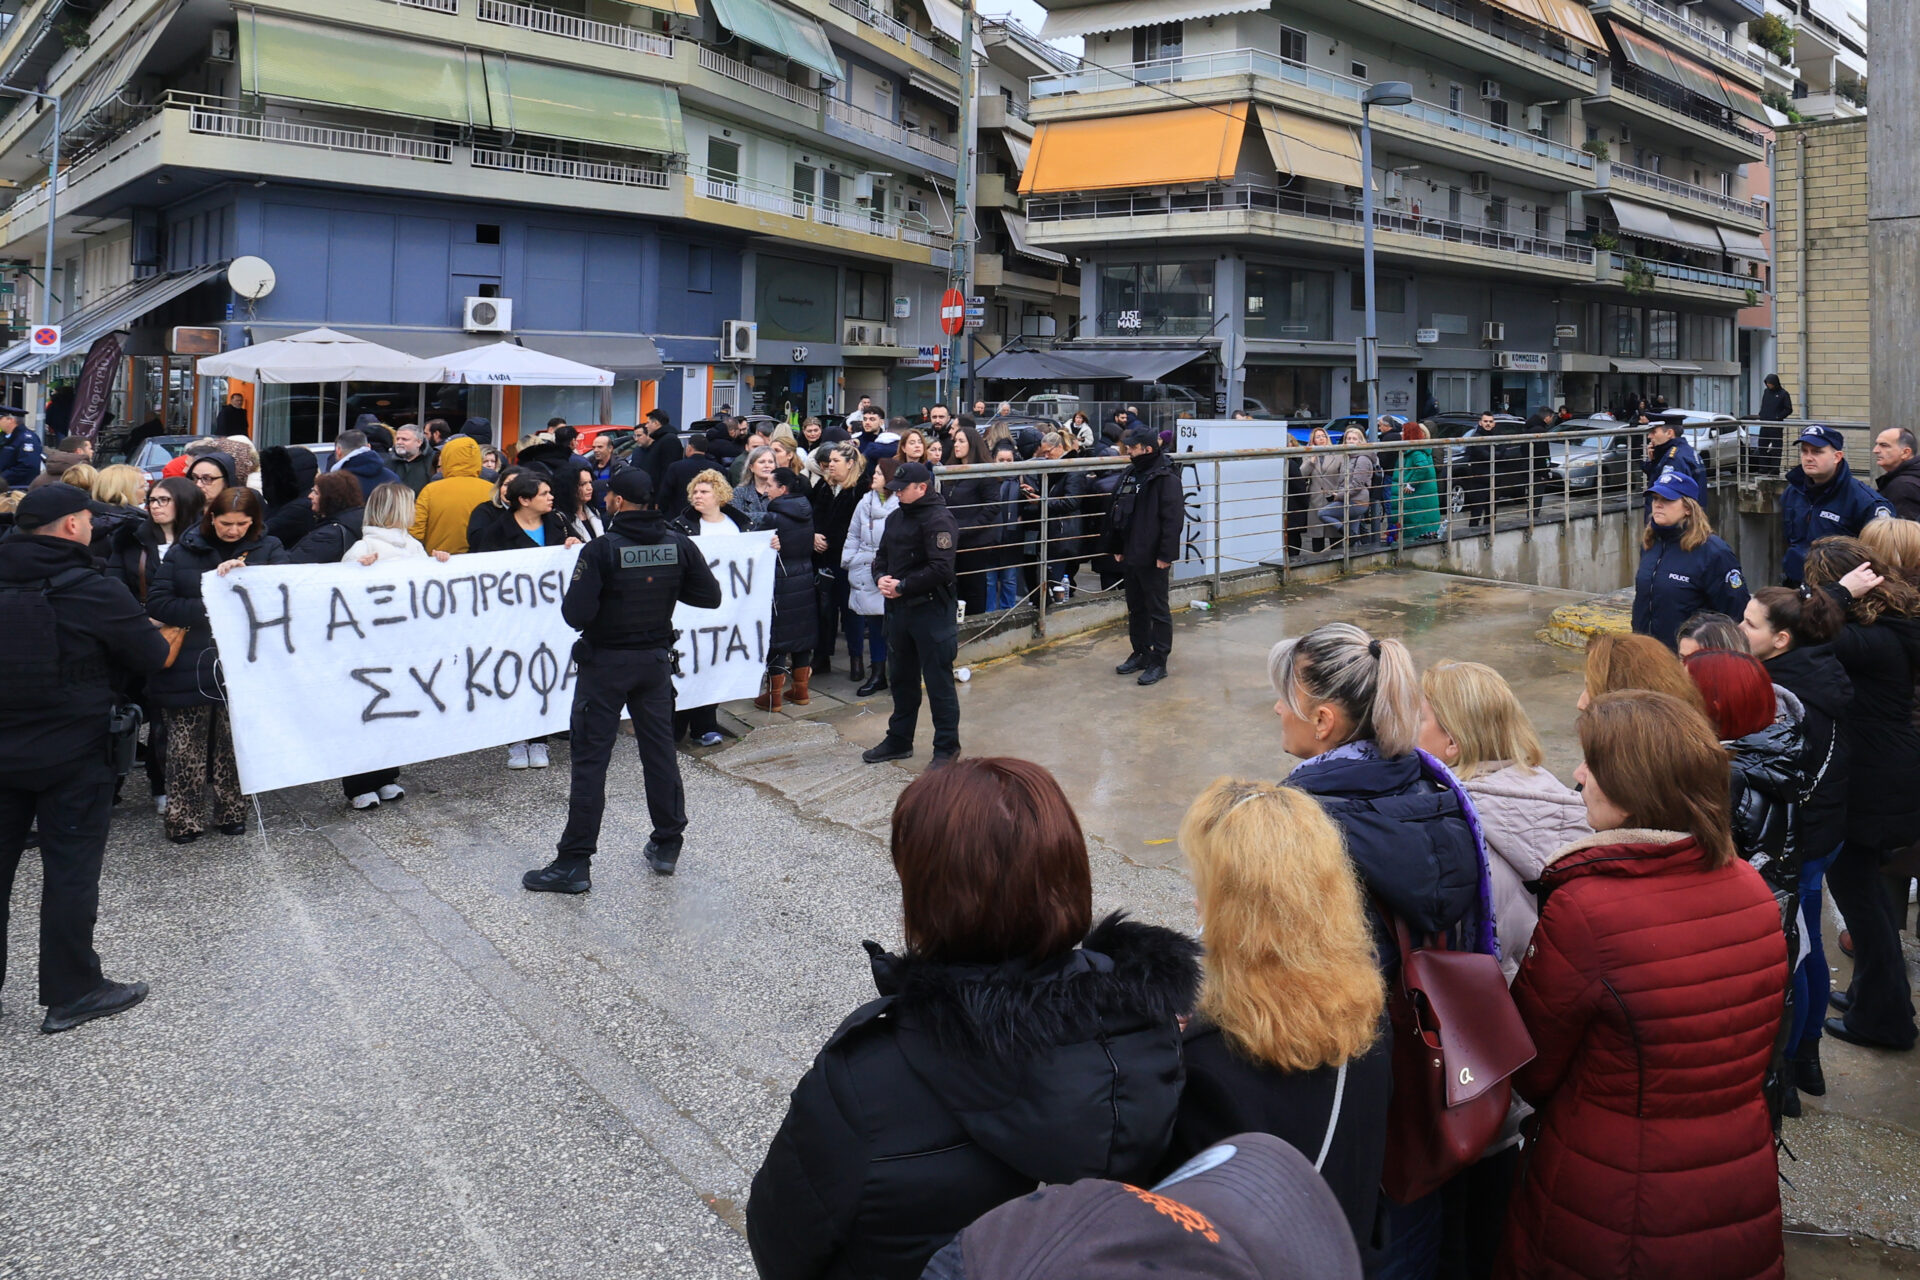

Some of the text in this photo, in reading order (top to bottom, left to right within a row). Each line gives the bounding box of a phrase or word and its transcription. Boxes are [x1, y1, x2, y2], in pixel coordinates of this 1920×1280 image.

[1120, 310, 1139, 320] JUST
[1117, 319, 1142, 328] MADE
[487, 373, 511, 381] ΑΛΦΑ
[1180, 426, 1197, 438] 634
[1668, 572, 1690, 583] POLICE
[232, 583, 296, 662] Η
[326, 570, 569, 641] ΑΞΙΟΠΡΕΠΕΙ
